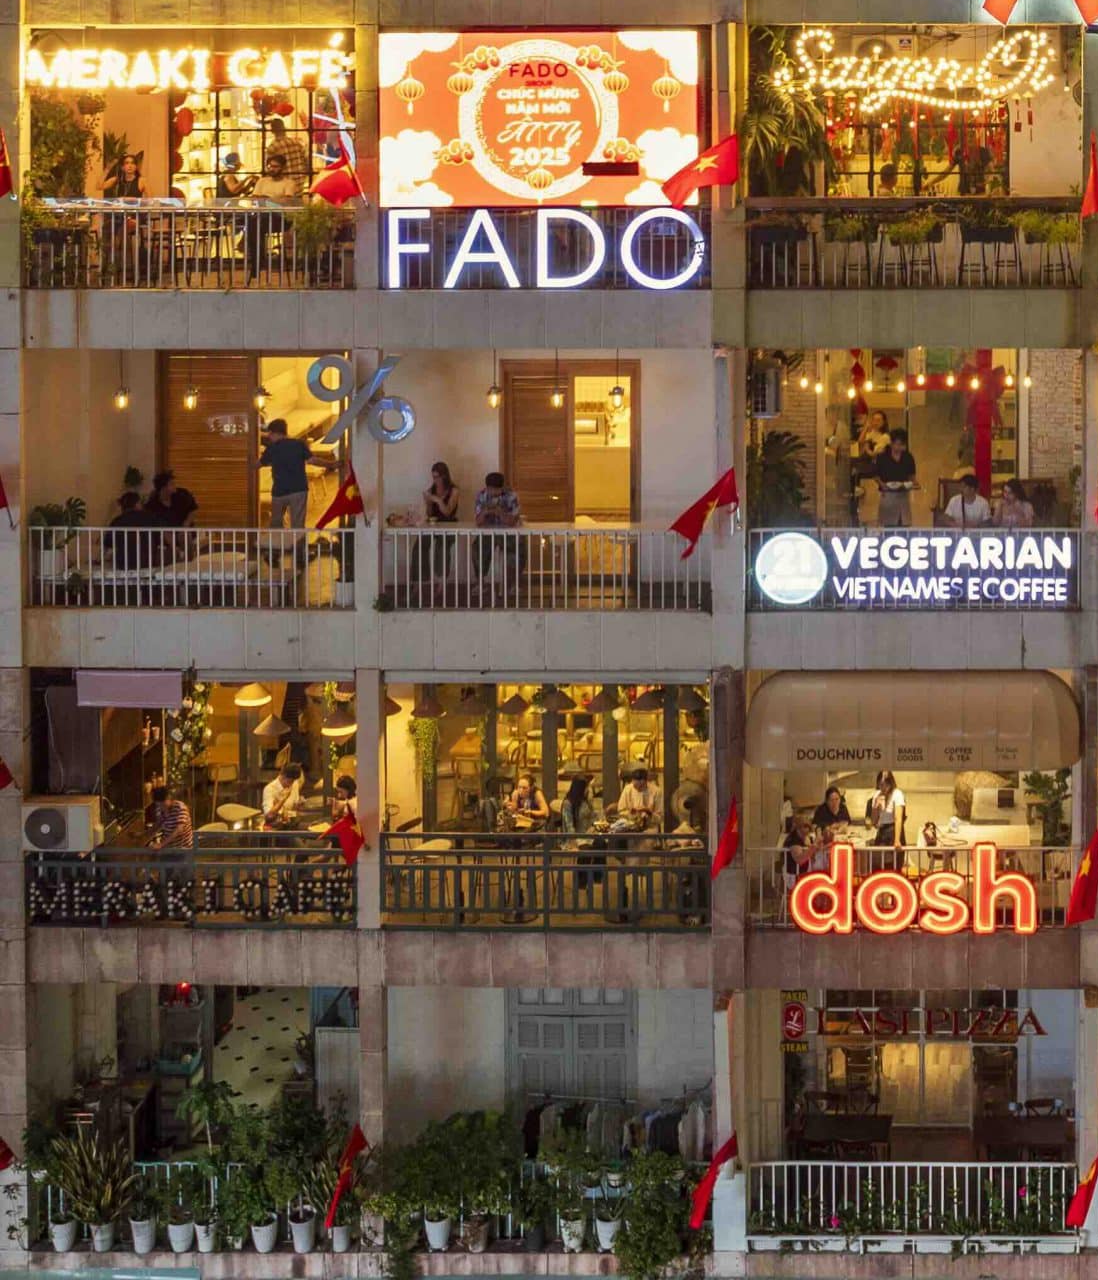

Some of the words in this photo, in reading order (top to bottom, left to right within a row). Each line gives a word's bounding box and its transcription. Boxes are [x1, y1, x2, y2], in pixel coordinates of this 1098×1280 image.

[26, 48, 212, 89] MERAKI
[507, 63, 569, 78] FADO
[509, 146, 572, 166] 2025
[386, 208, 705, 290] FADO
[830, 535, 1072, 570] VEGETARIAN
[982, 576, 1069, 602] COFFEE
[796, 747, 882, 761] DOUGHNUTS
[27, 880, 219, 918] MERAKI
[790, 842, 1038, 934] dosh
[924, 1006, 1049, 1036] PIZZA
